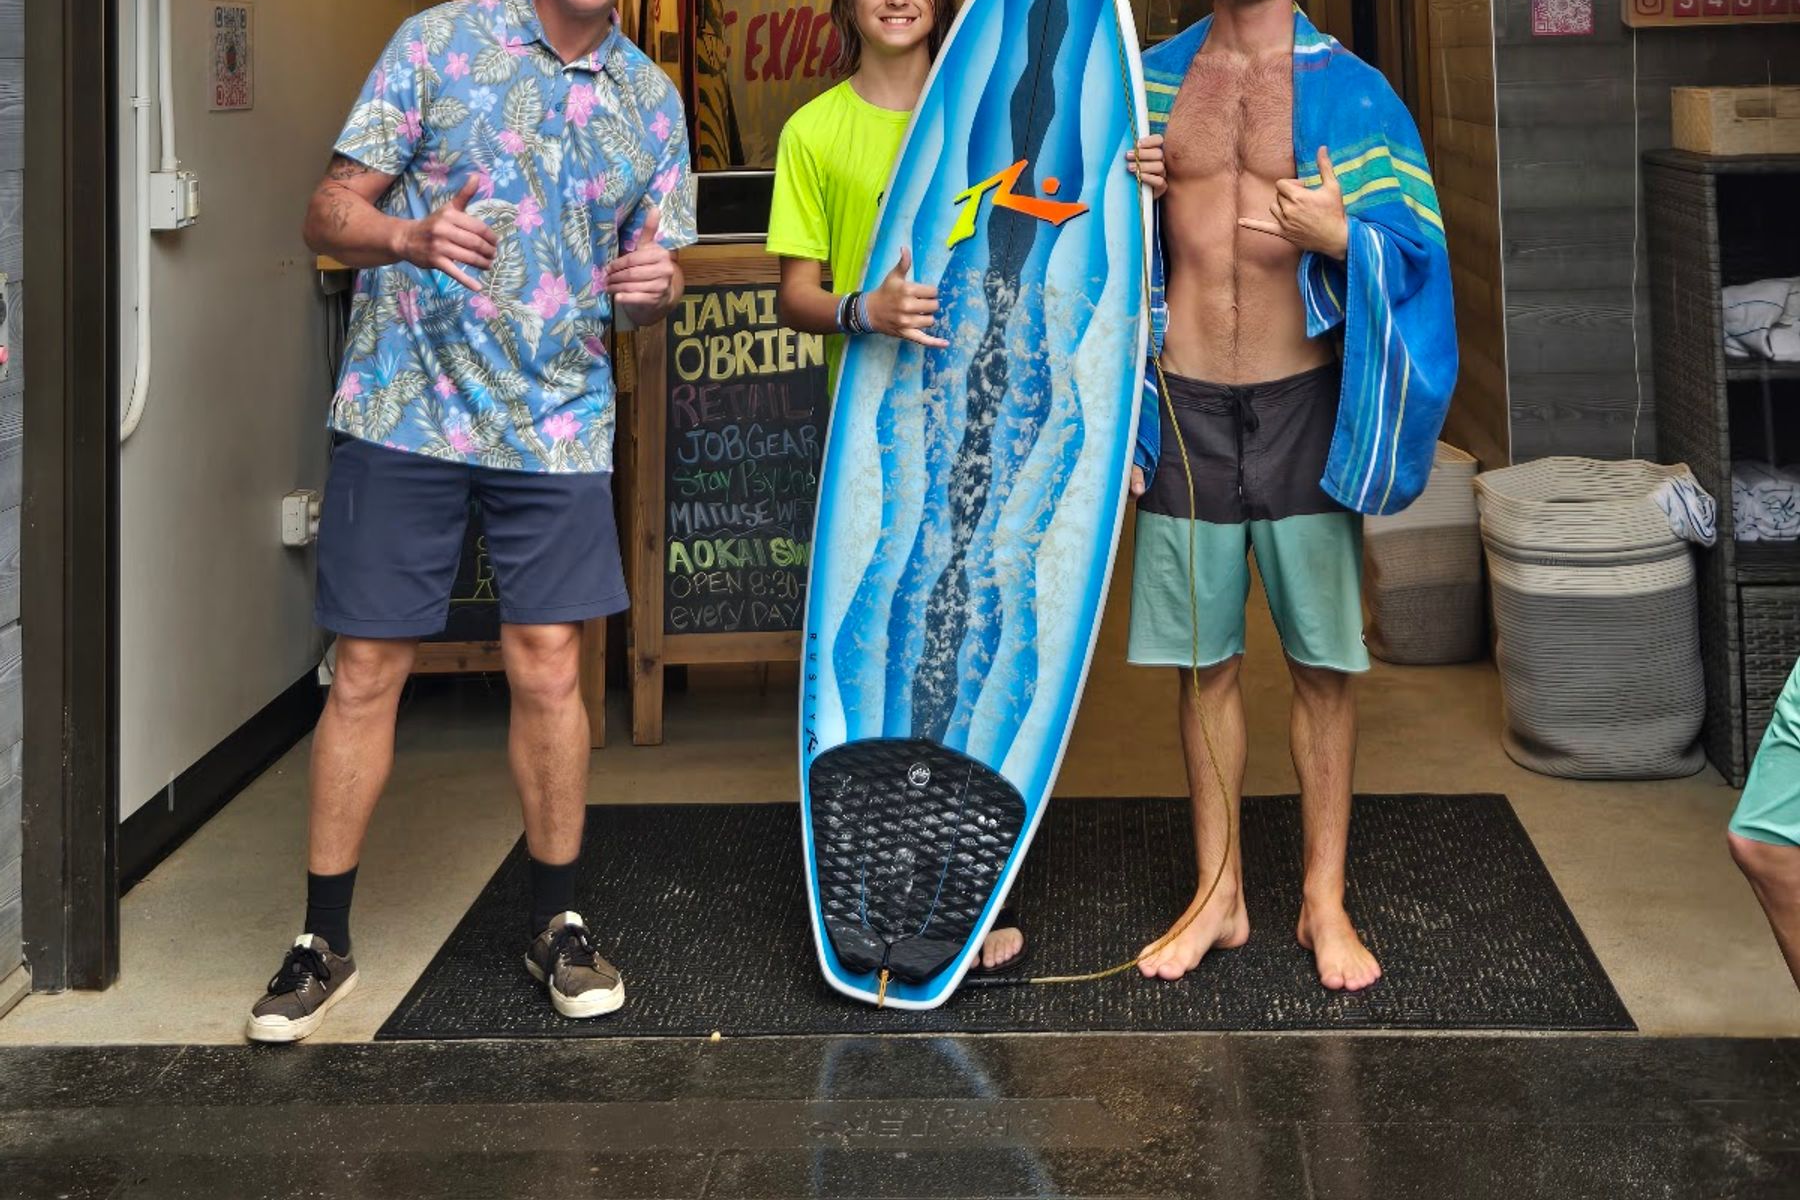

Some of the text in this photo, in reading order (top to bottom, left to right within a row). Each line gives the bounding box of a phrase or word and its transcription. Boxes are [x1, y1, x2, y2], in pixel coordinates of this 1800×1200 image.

[674, 288, 777, 337] JAMI
[674, 326, 825, 382] O'BRIEN
[672, 382, 809, 428] RETAIL
[670, 497, 774, 535] MATUSE
[668, 538, 768, 575] AOKAI
[670, 571, 743, 599] OPEN
[751, 599, 802, 628] DAY
[807, 632, 818, 721] RUSTY
